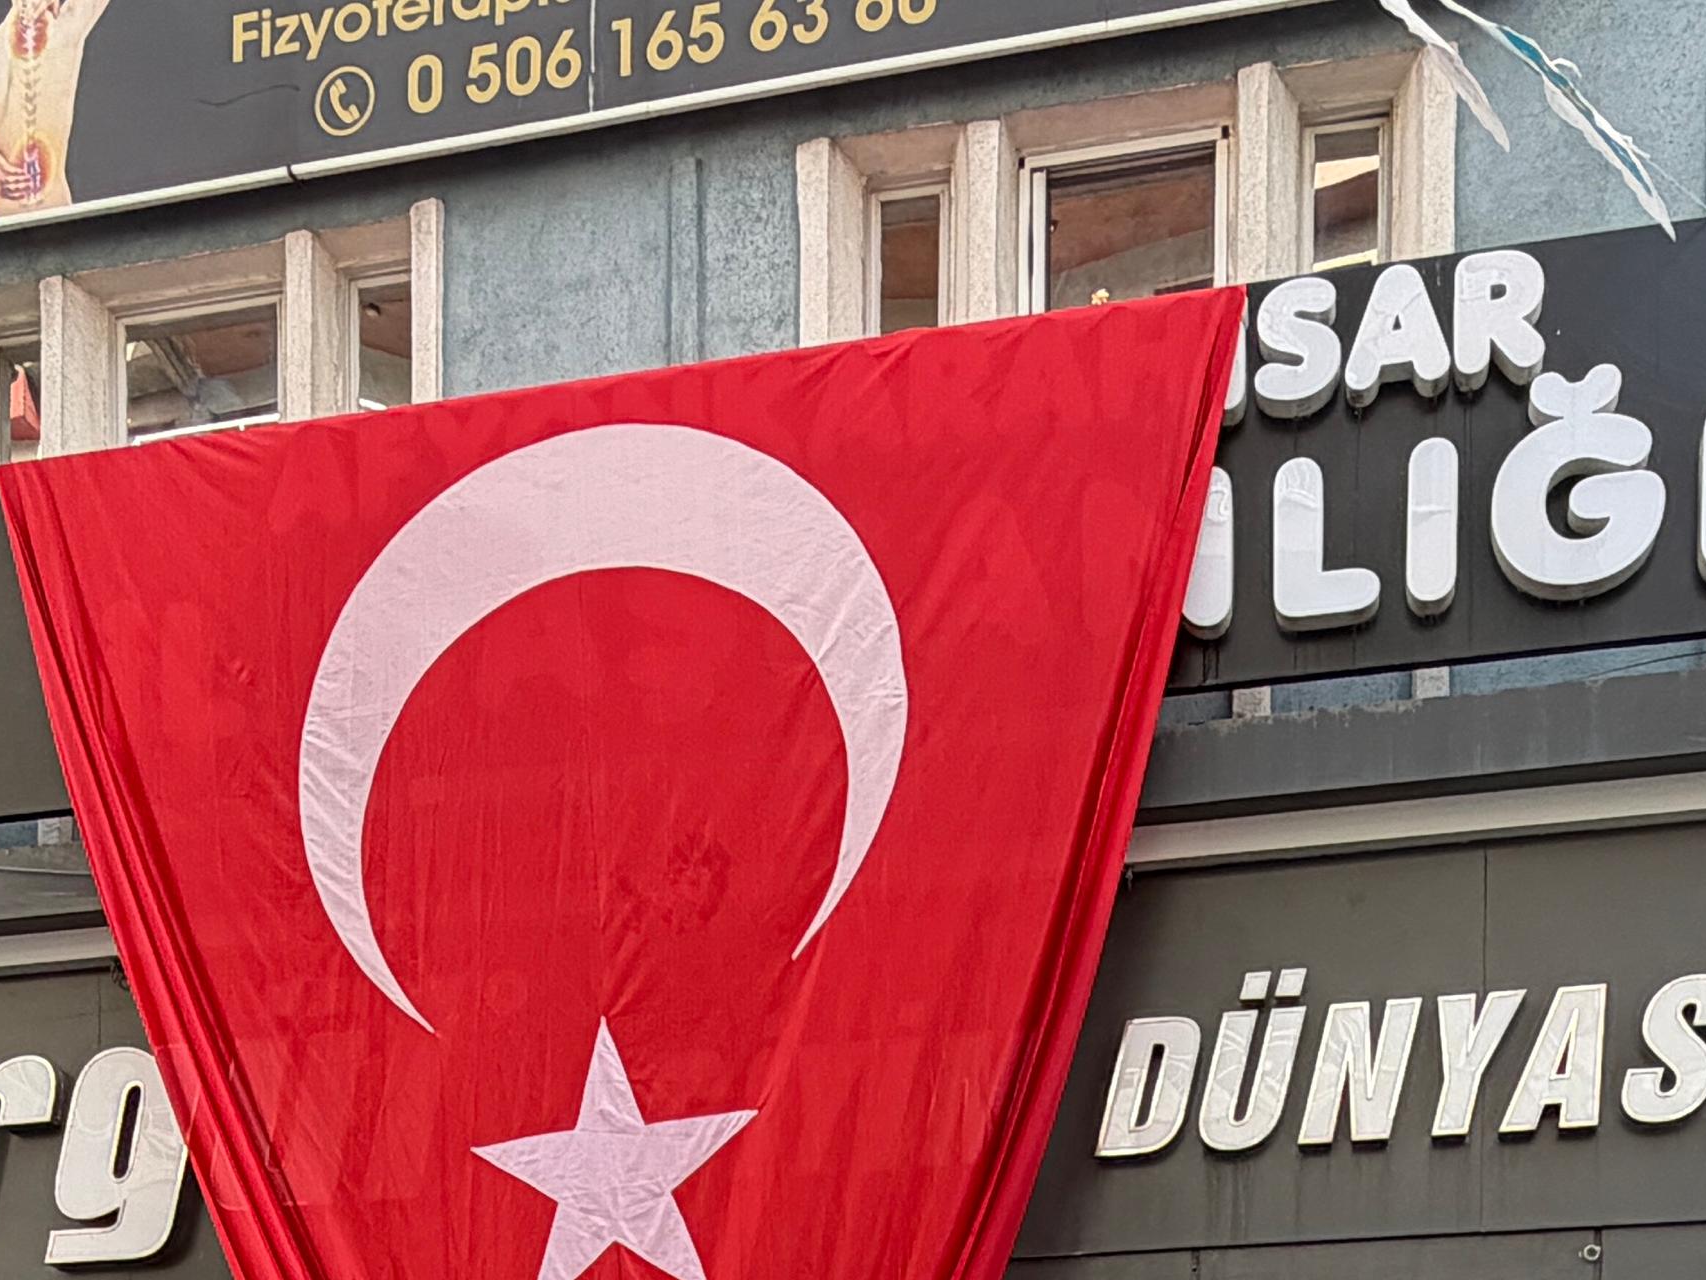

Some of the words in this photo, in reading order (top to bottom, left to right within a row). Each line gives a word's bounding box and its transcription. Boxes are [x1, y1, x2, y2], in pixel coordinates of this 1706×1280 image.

[407, 54, 443, 114] 0
[465, 28, 583, 104] 506
[611, 1, 725, 77] 165
[750, 0, 830, 51] 63
[1222, 249, 1546, 427] SAR
